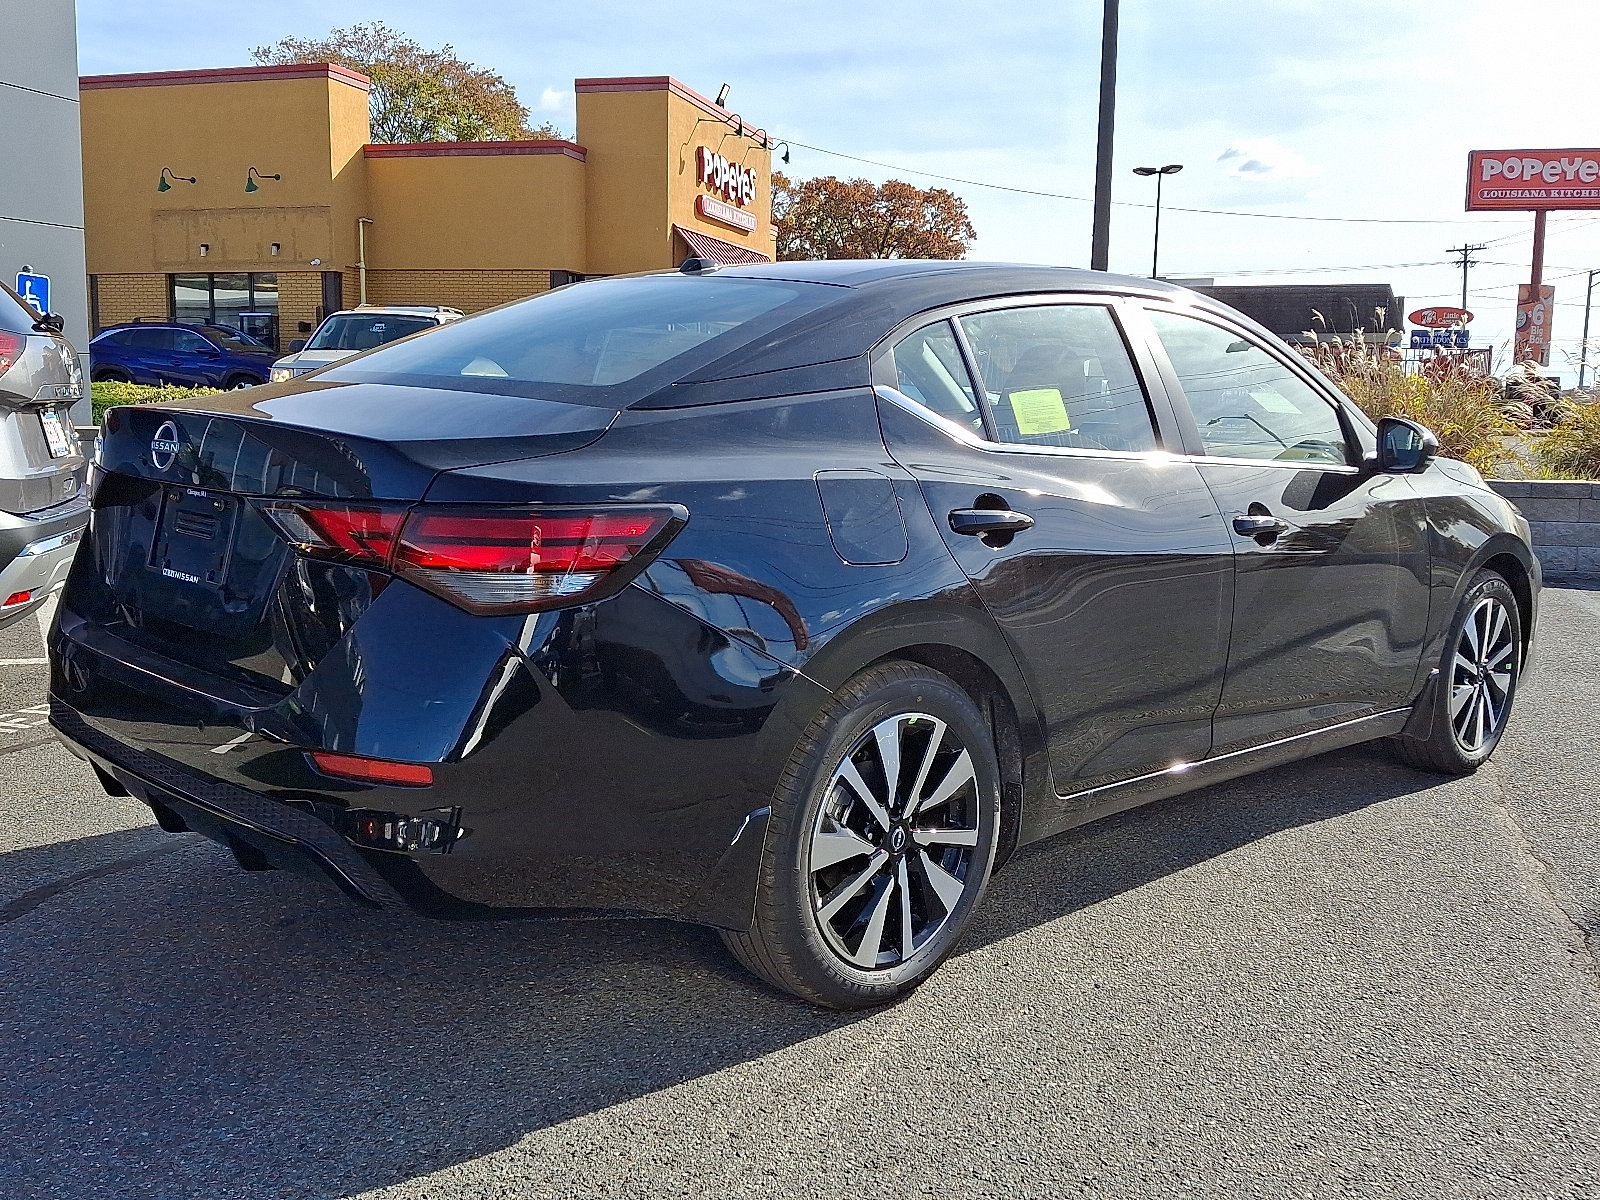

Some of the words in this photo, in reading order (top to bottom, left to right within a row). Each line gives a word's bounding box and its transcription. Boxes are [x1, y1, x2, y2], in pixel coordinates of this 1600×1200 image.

[1481, 157, 1600, 183] POPeYe
[1483, 189, 1547, 198] LOUISIANA
[1530, 325, 1544, 337] Big
[1412, 336, 1467, 344] ORTHODONICS
